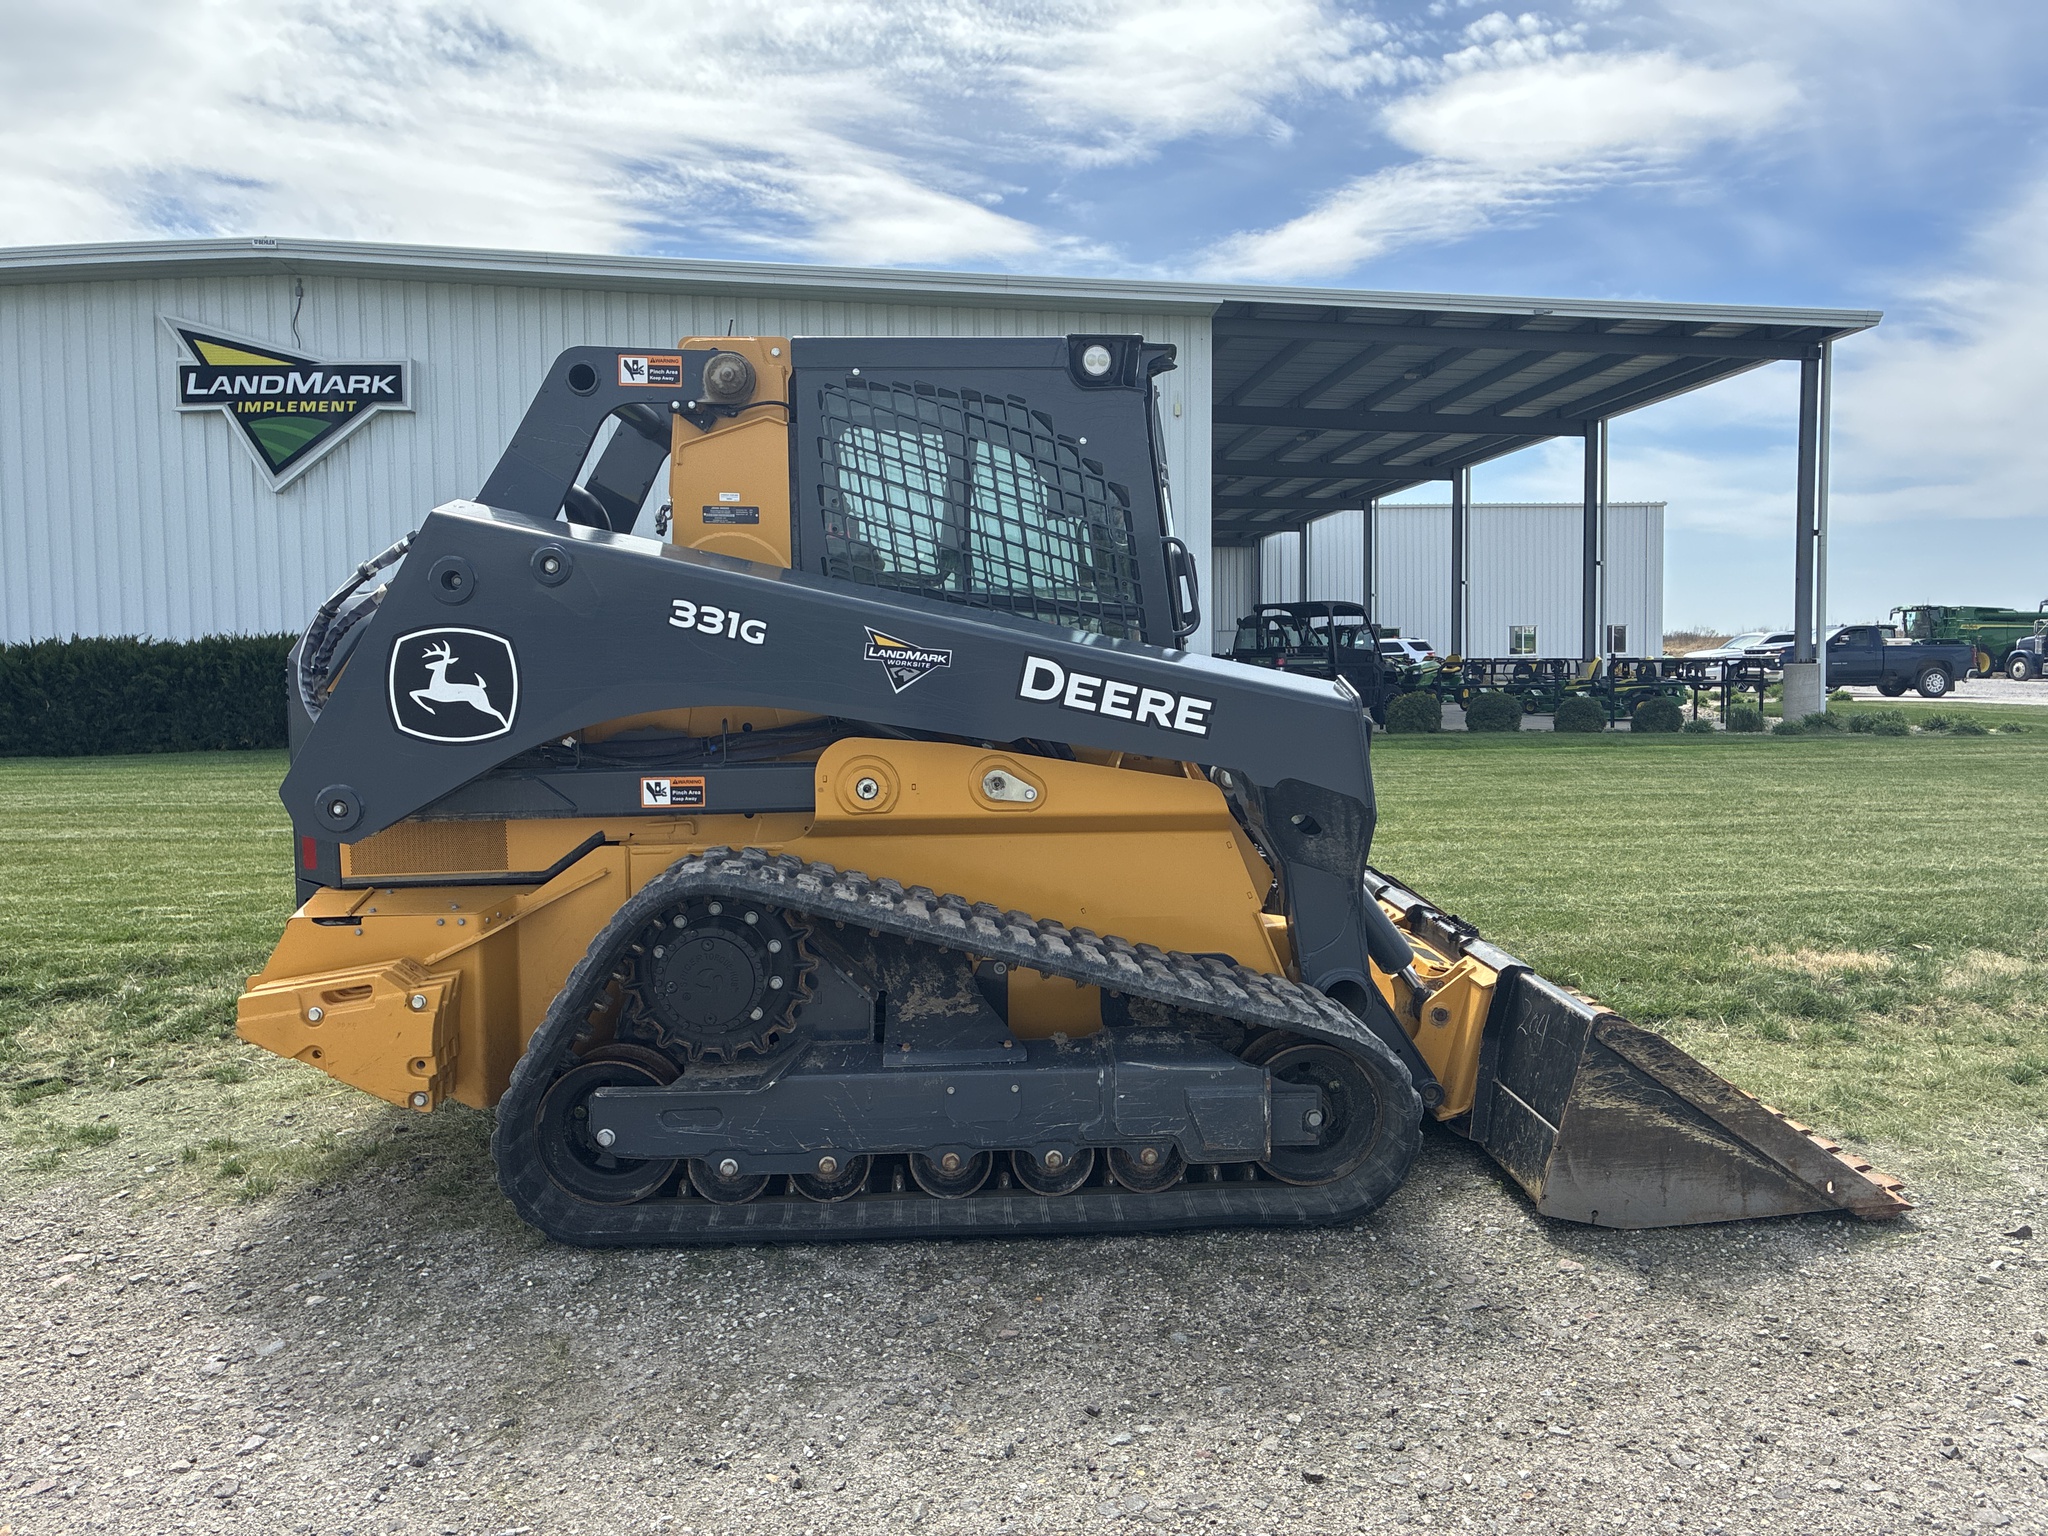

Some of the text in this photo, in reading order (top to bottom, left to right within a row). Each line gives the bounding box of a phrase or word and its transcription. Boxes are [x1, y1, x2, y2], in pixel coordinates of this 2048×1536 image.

[186, 372, 397, 395] LANDMARK
[237, 401, 357, 413] IMPLEMENT
[669, 599, 767, 645] 331G
[868, 646, 948, 664] LANDMARK
[887, 659, 931, 669] WORKSITE
[1019, 655, 1213, 735] DEERE
